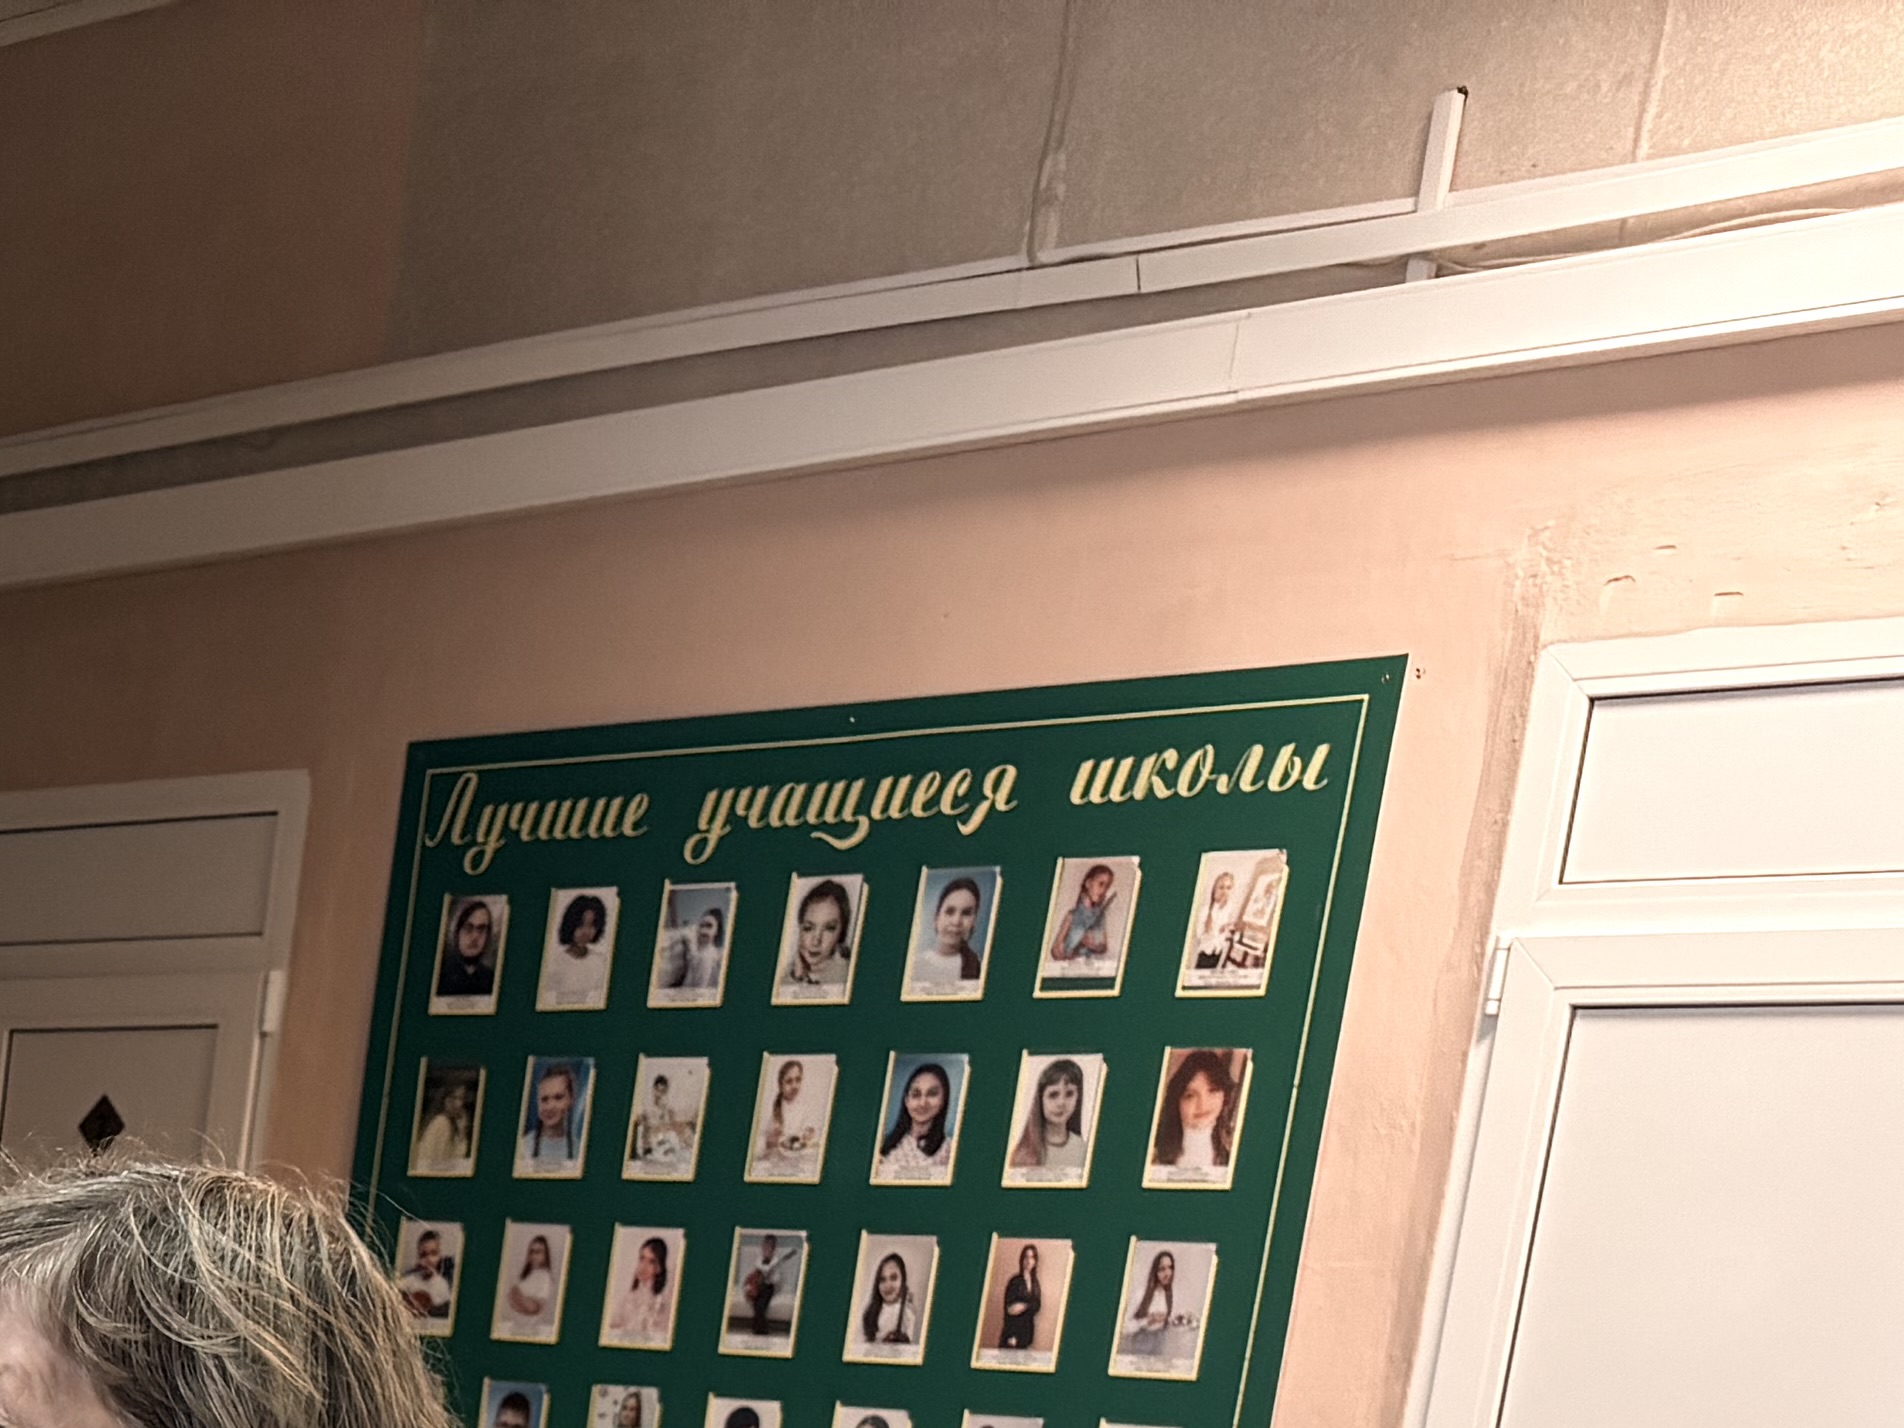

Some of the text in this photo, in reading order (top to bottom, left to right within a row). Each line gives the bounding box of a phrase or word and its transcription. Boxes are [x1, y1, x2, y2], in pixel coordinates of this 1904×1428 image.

[423, 742, 1332, 876] Лучшие учащиеся школы
